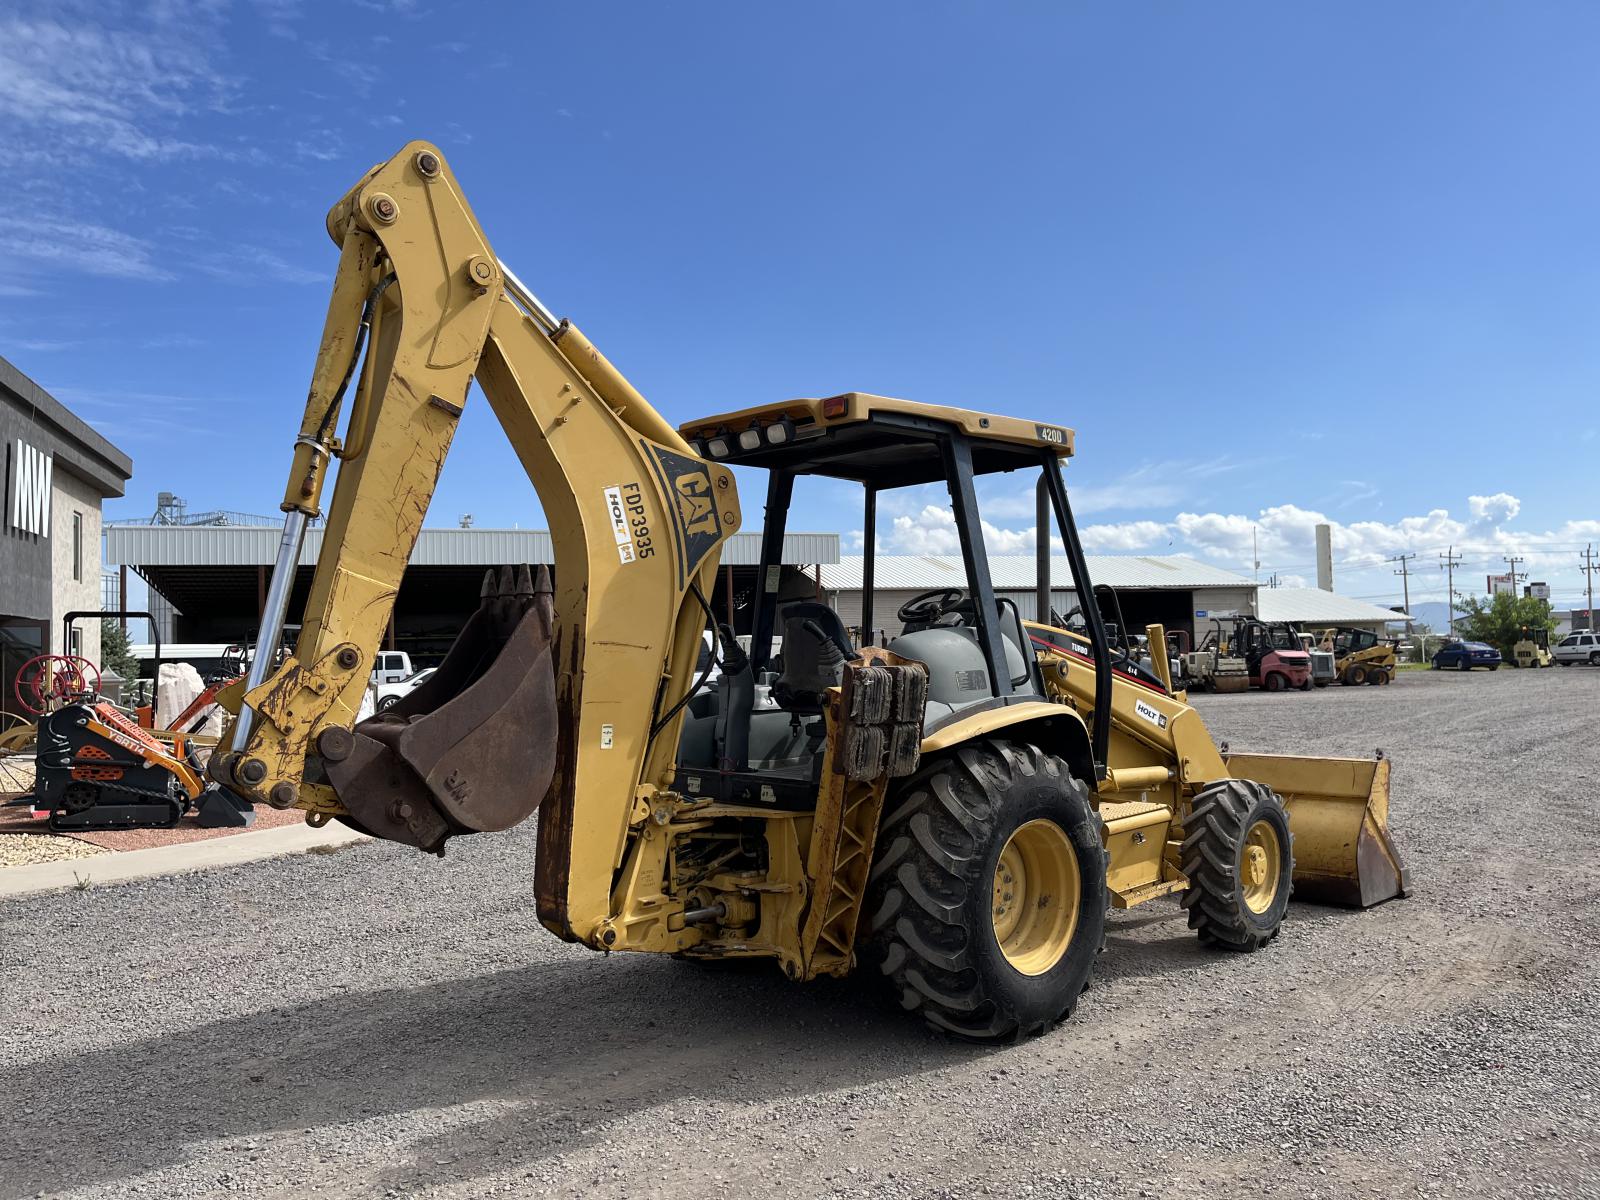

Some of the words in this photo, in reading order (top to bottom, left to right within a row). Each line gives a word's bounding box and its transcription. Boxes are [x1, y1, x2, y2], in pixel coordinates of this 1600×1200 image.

[609, 493, 627, 538] HOLT
[623, 482, 655, 559] FDP3935
[675, 472, 718, 535] CAT
[1071, 642, 1089, 656] TURBO
[1137, 704, 1157, 719] HOLT
